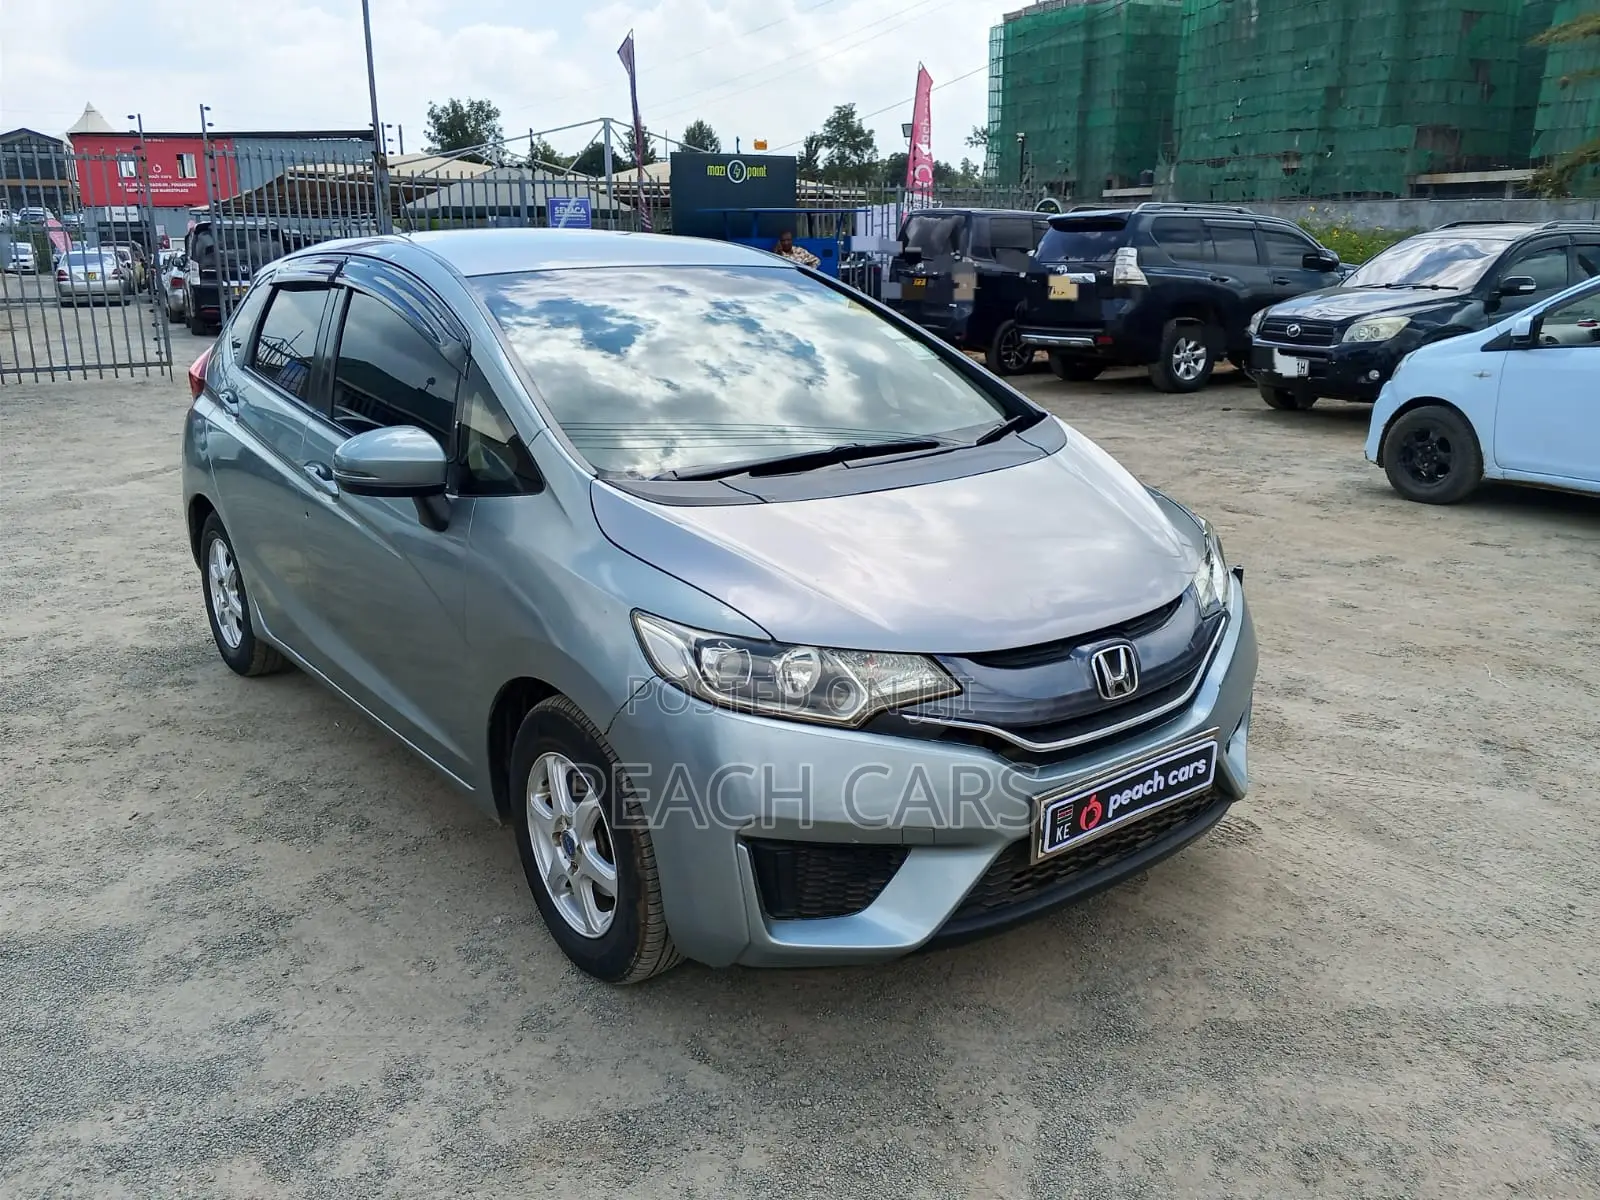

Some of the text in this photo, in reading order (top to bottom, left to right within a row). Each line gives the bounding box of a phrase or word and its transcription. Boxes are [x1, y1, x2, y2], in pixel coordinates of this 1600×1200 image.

[746, 165, 767, 180] point
[1107, 757, 1207, 819] peach cars
[1055, 822, 1072, 843] KE
